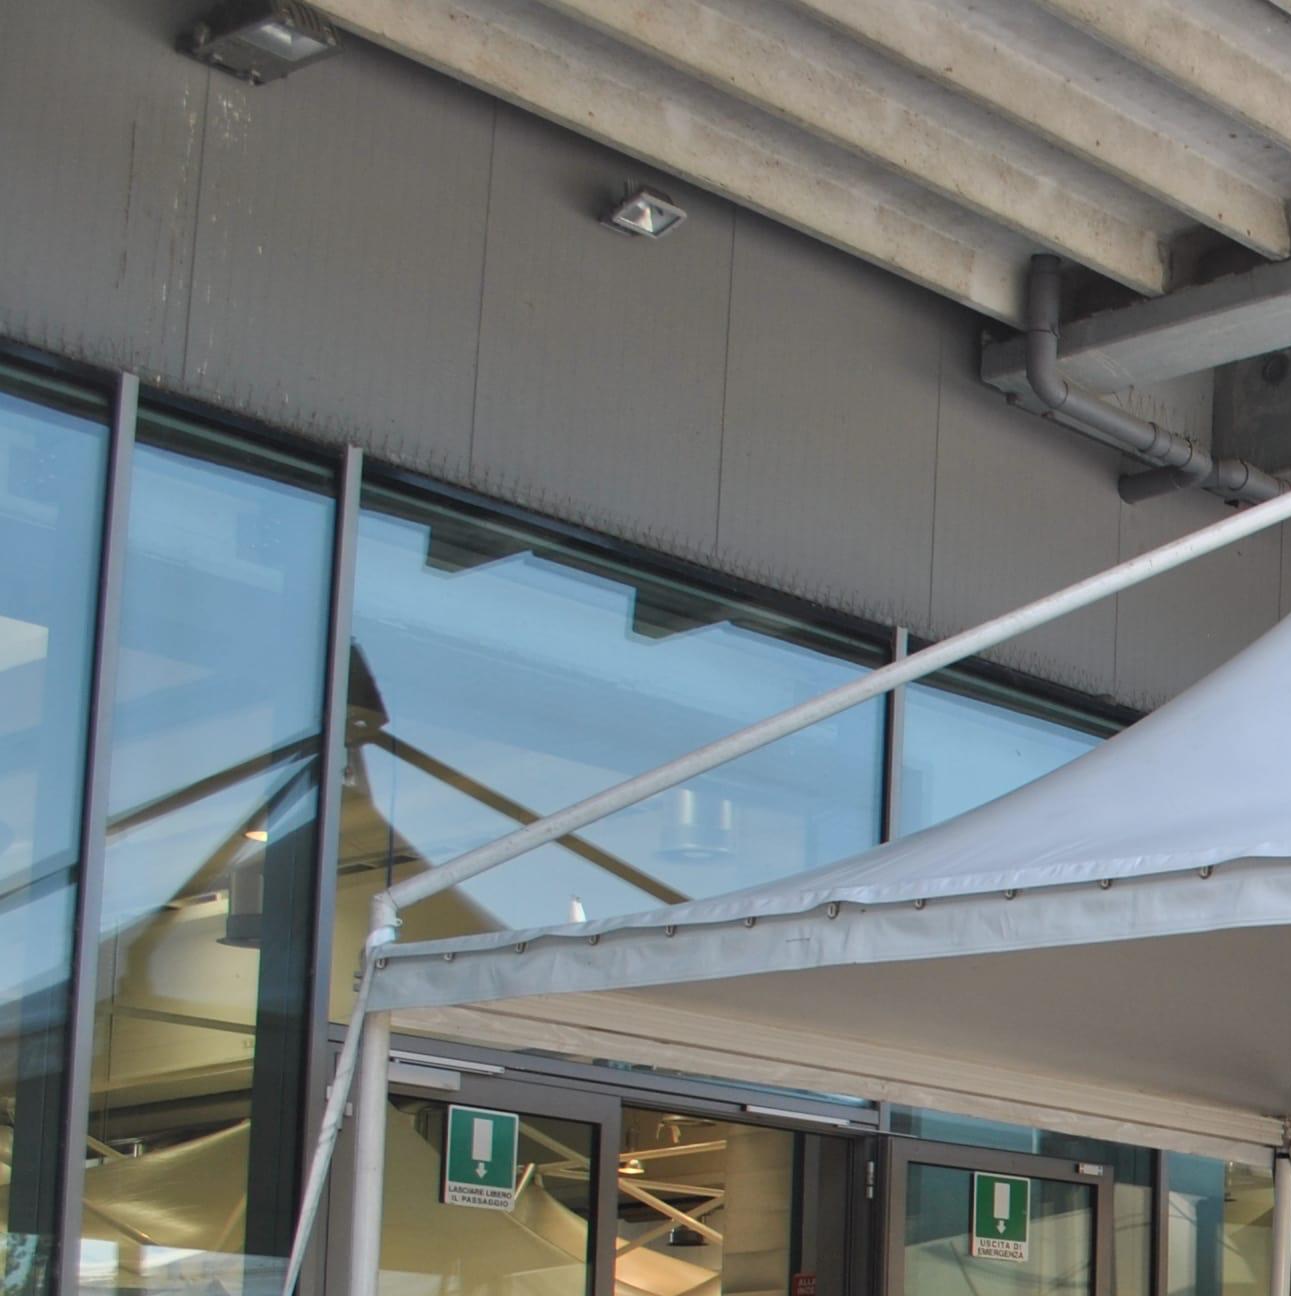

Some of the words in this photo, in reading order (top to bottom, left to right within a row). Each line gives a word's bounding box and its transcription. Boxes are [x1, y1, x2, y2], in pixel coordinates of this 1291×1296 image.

[449, 1186, 484, 1195] LASCIARE
[486, 1190, 512, 1199] LIBERO
[462, 1196, 508, 1207] PASSAGGIO
[980, 1240, 1010, 1249] USCITA
[978, 1248, 1024, 1259] EMERGENZA
